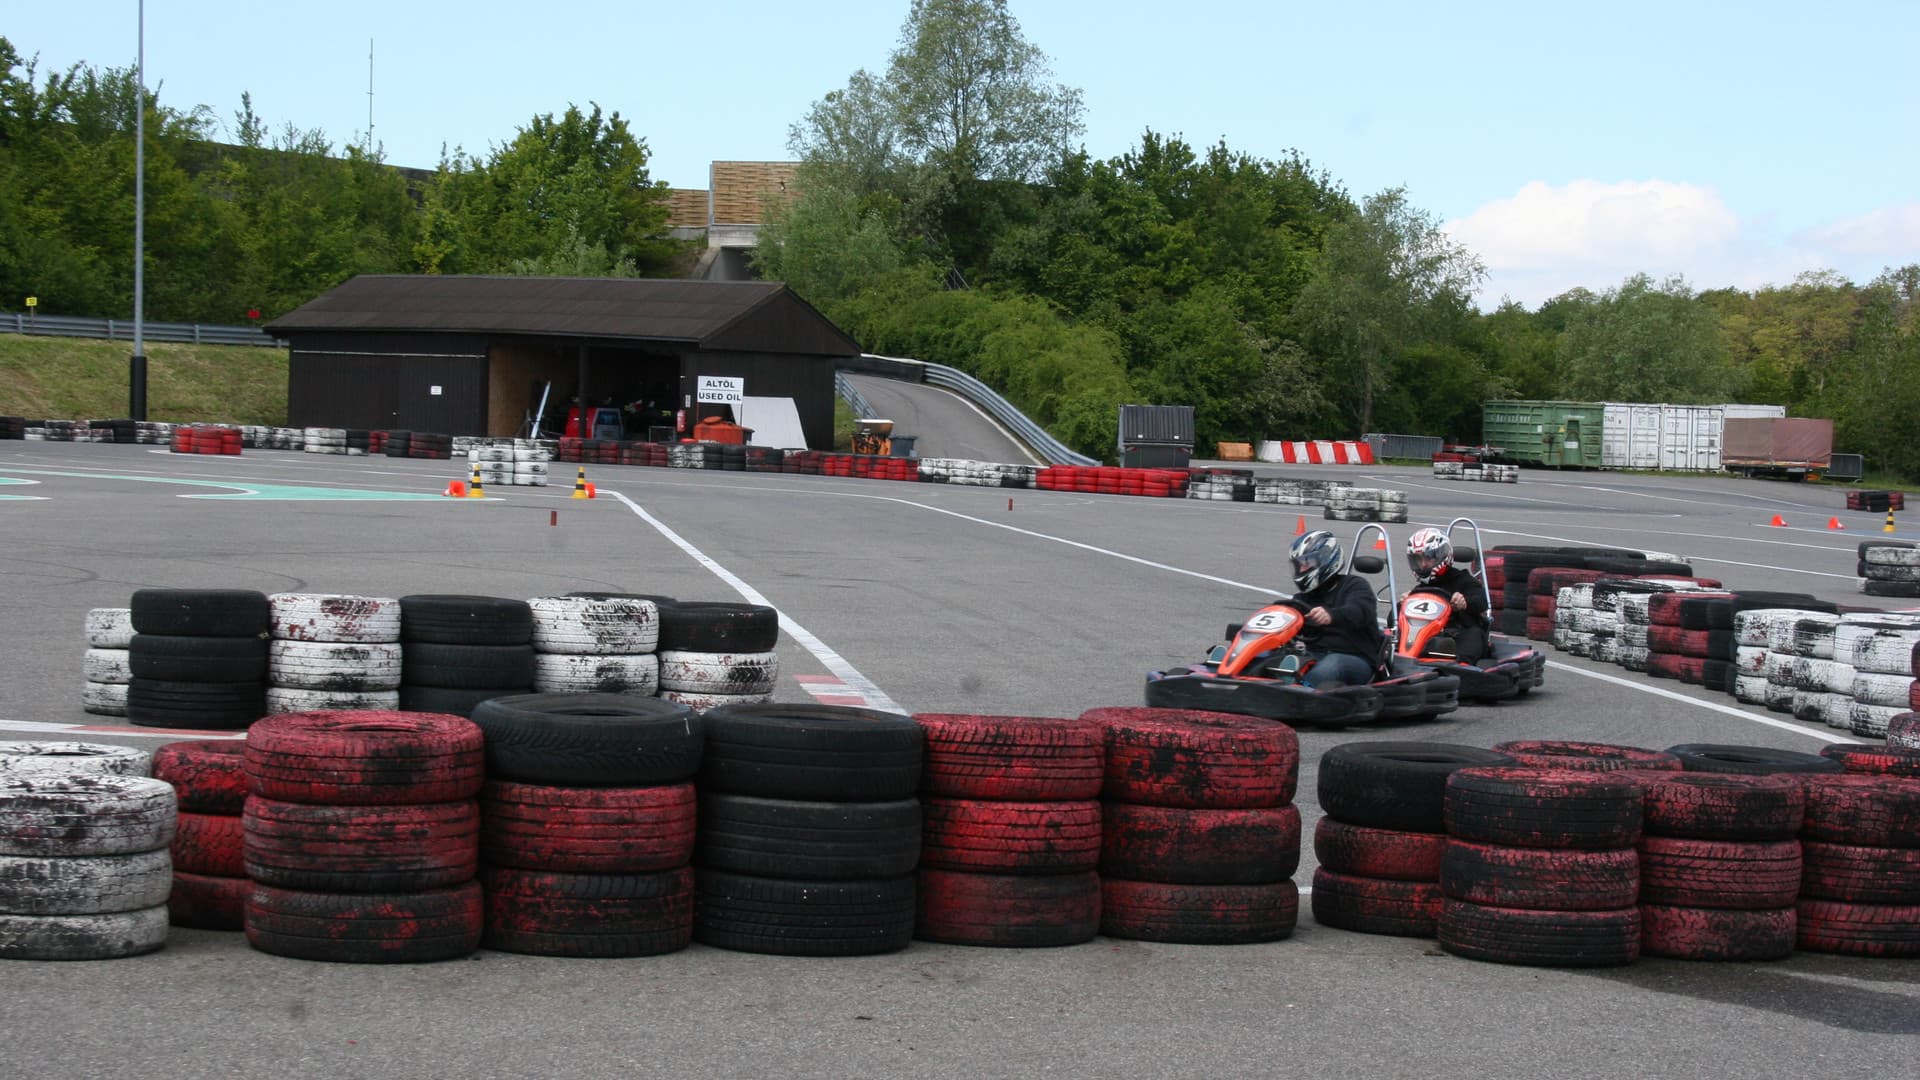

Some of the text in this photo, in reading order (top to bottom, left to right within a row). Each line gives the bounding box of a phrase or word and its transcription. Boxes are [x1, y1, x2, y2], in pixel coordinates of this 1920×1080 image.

[698, 391, 742, 402] USED OIL
[1413, 601, 1430, 613] 4
[1255, 615, 1276, 627] 5
